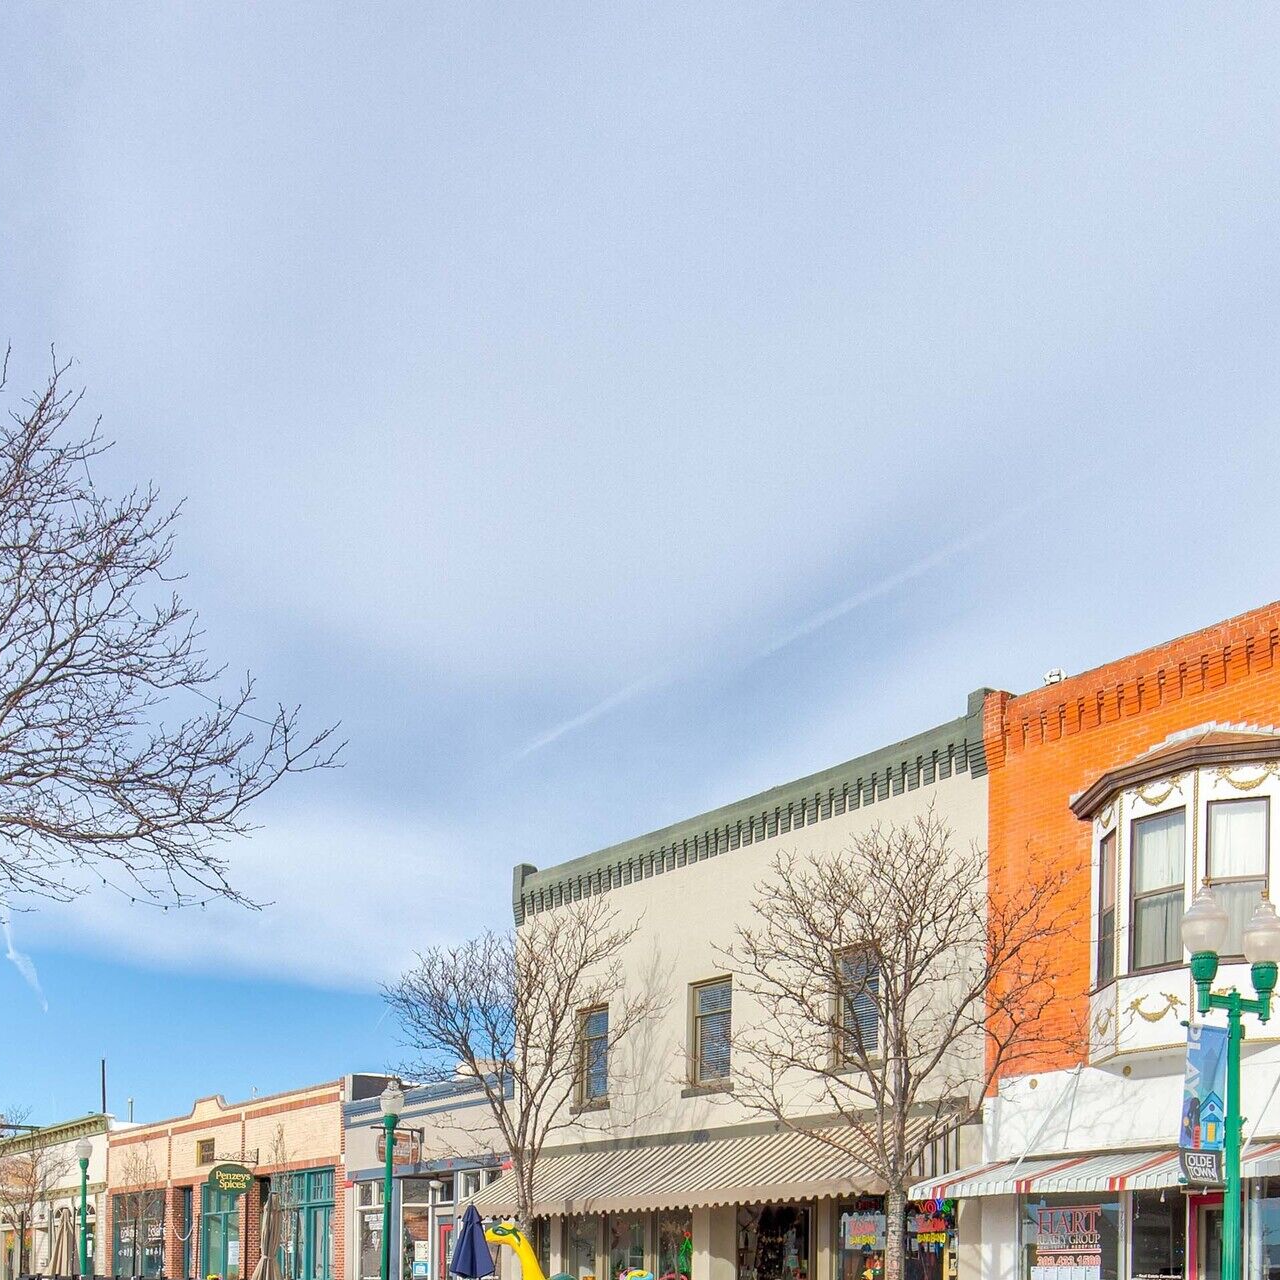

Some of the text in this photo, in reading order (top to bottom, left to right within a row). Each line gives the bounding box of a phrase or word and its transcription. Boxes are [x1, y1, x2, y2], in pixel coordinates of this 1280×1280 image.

[1184, 1025, 1201, 1098] PLAY
[1188, 1155, 1212, 1168] OLDE
[215, 1170, 251, 1182] Penzeys
[1188, 1165, 1216, 1179] TOWN
[219, 1179, 247, 1190] Spices
[914, 1198, 953, 1214] TOYS
[1036, 1210, 1101, 1234] HART
[1068, 1233, 1101, 1245] GROUP
